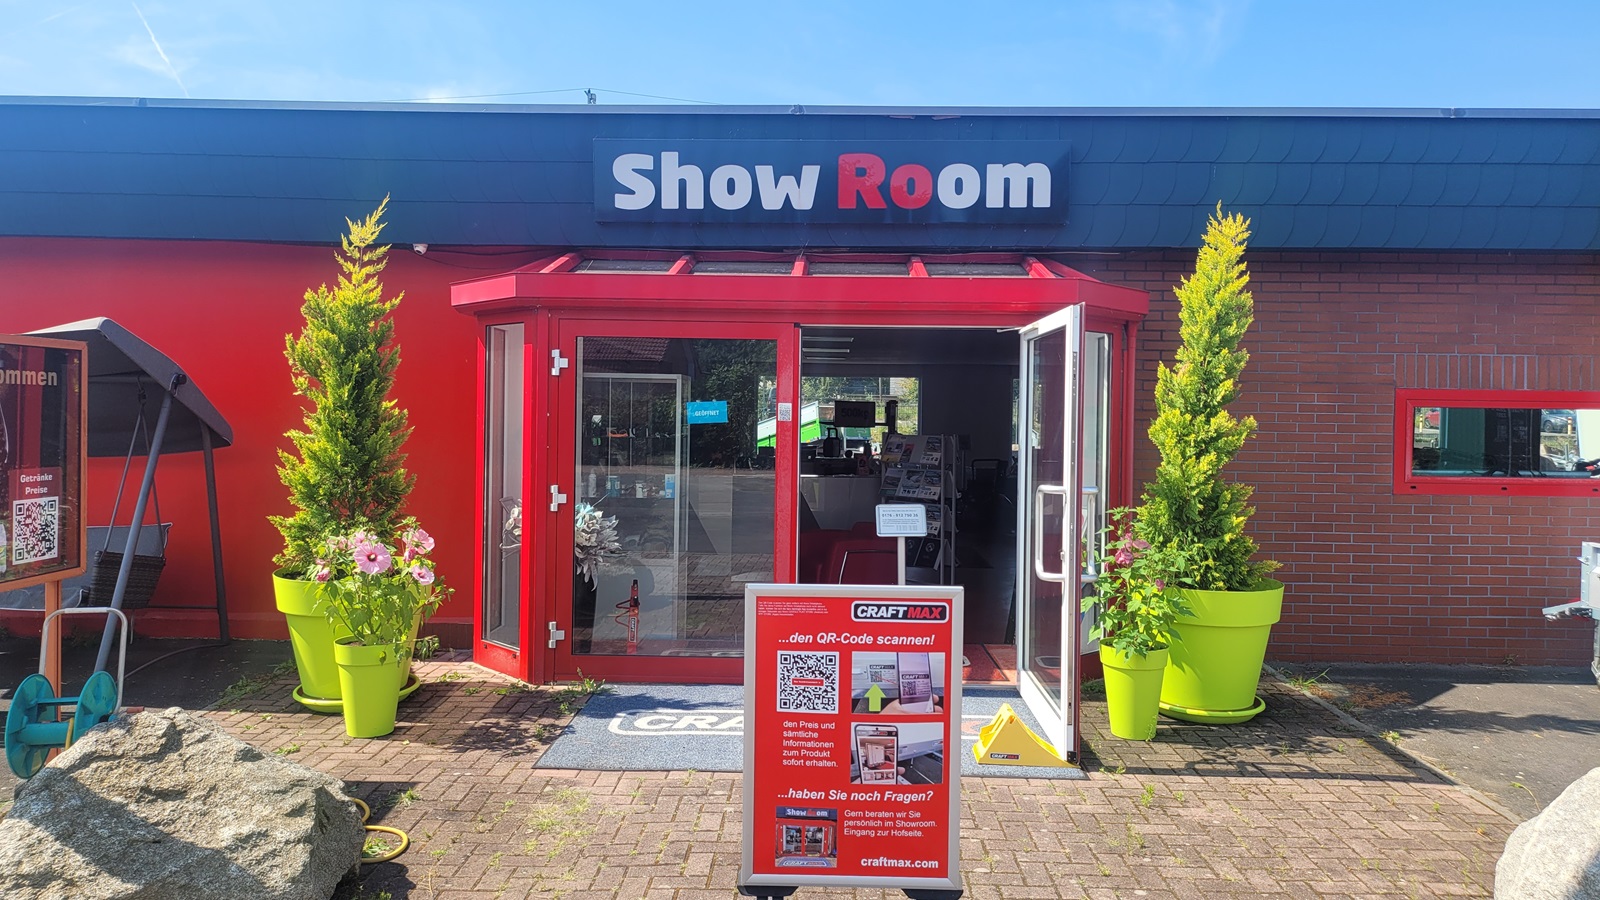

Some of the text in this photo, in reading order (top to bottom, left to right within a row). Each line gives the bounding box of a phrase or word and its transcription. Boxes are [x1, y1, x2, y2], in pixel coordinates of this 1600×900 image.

[612, 151, 1052, 211] Show Room
[20, 473, 53, 483] Getränke
[25, 485, 48, 495] Preise
[816, 632, 874, 645] QR-Code
[876, 634, 936, 646] scannen!
[782, 720, 836, 730] den Preis und
[782, 730, 819, 739] sämtliche
[782, 740, 835, 749] Informationen
[800, 749, 831, 758] Produkt
[782, 758, 839, 768] sofort erhalten.
[828, 790, 848, 801] Sie
[850, 791, 881, 801] noch
[884, 791, 934, 804] Fragen?
[844, 809, 921, 819] Gern beraten wir Sie
[843, 819, 938, 829] persönlich im Showroom.
[843, 828, 876, 838] Eingang
[891, 829, 925, 838] Hofseite.
[860, 856, 939, 869] craftmax.com
